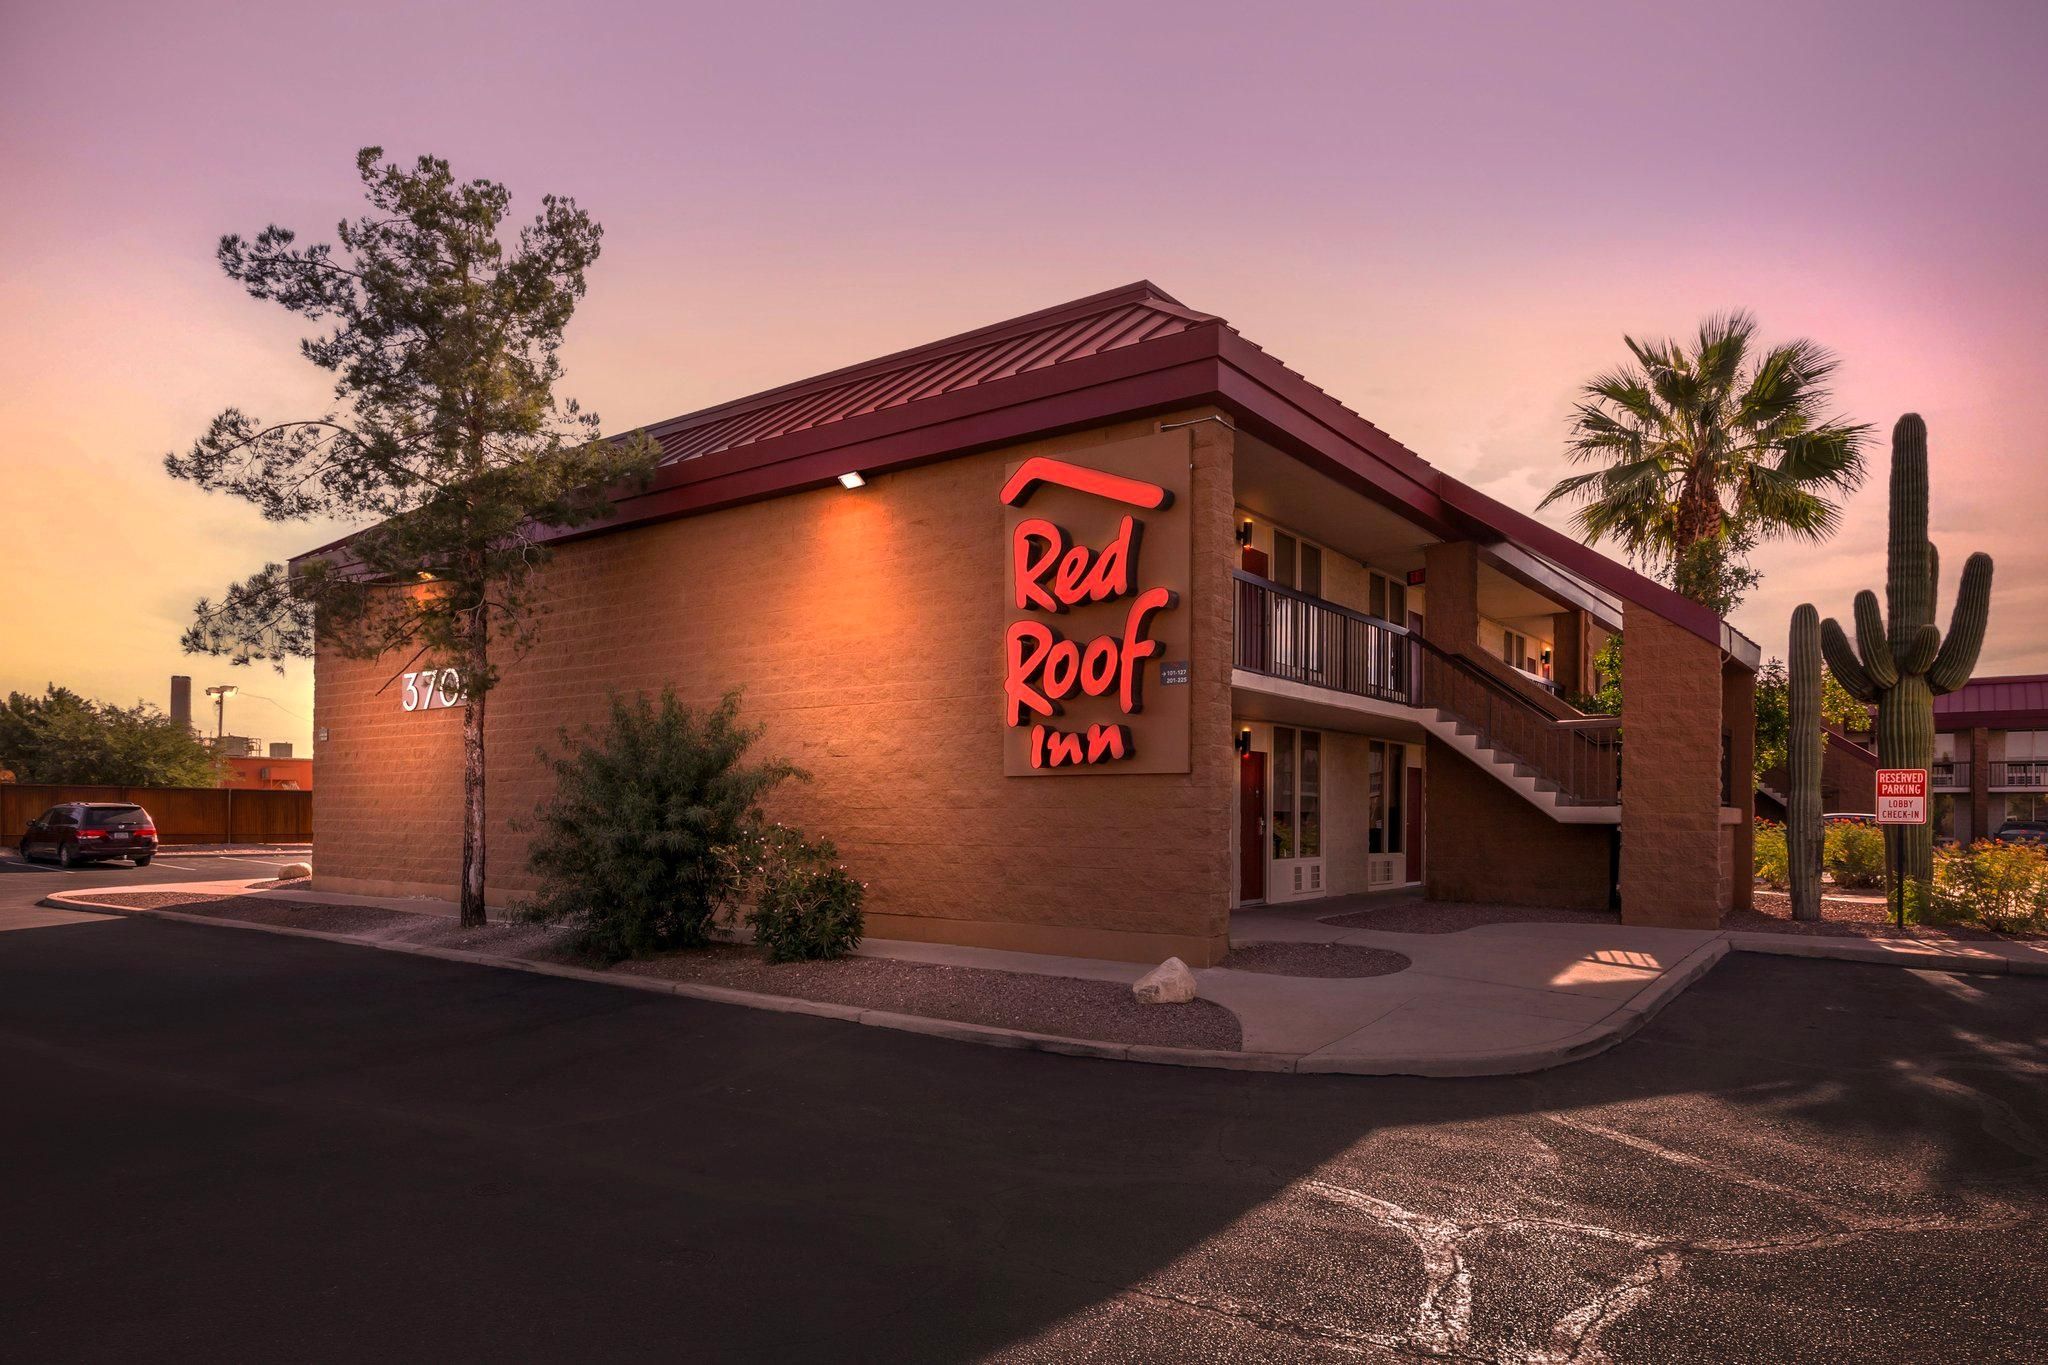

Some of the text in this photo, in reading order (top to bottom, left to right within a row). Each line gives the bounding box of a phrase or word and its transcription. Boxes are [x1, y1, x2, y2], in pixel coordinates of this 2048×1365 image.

[1013, 515, 1133, 613] Red
[1003, 587, 1169, 728] Roof
[402, 668, 468, 711] 370
[1879, 773, 1924, 783] RESERVED
[1881, 784, 1921, 794] PARKING
[1882, 810, 1920, 818] CHECK-IN
